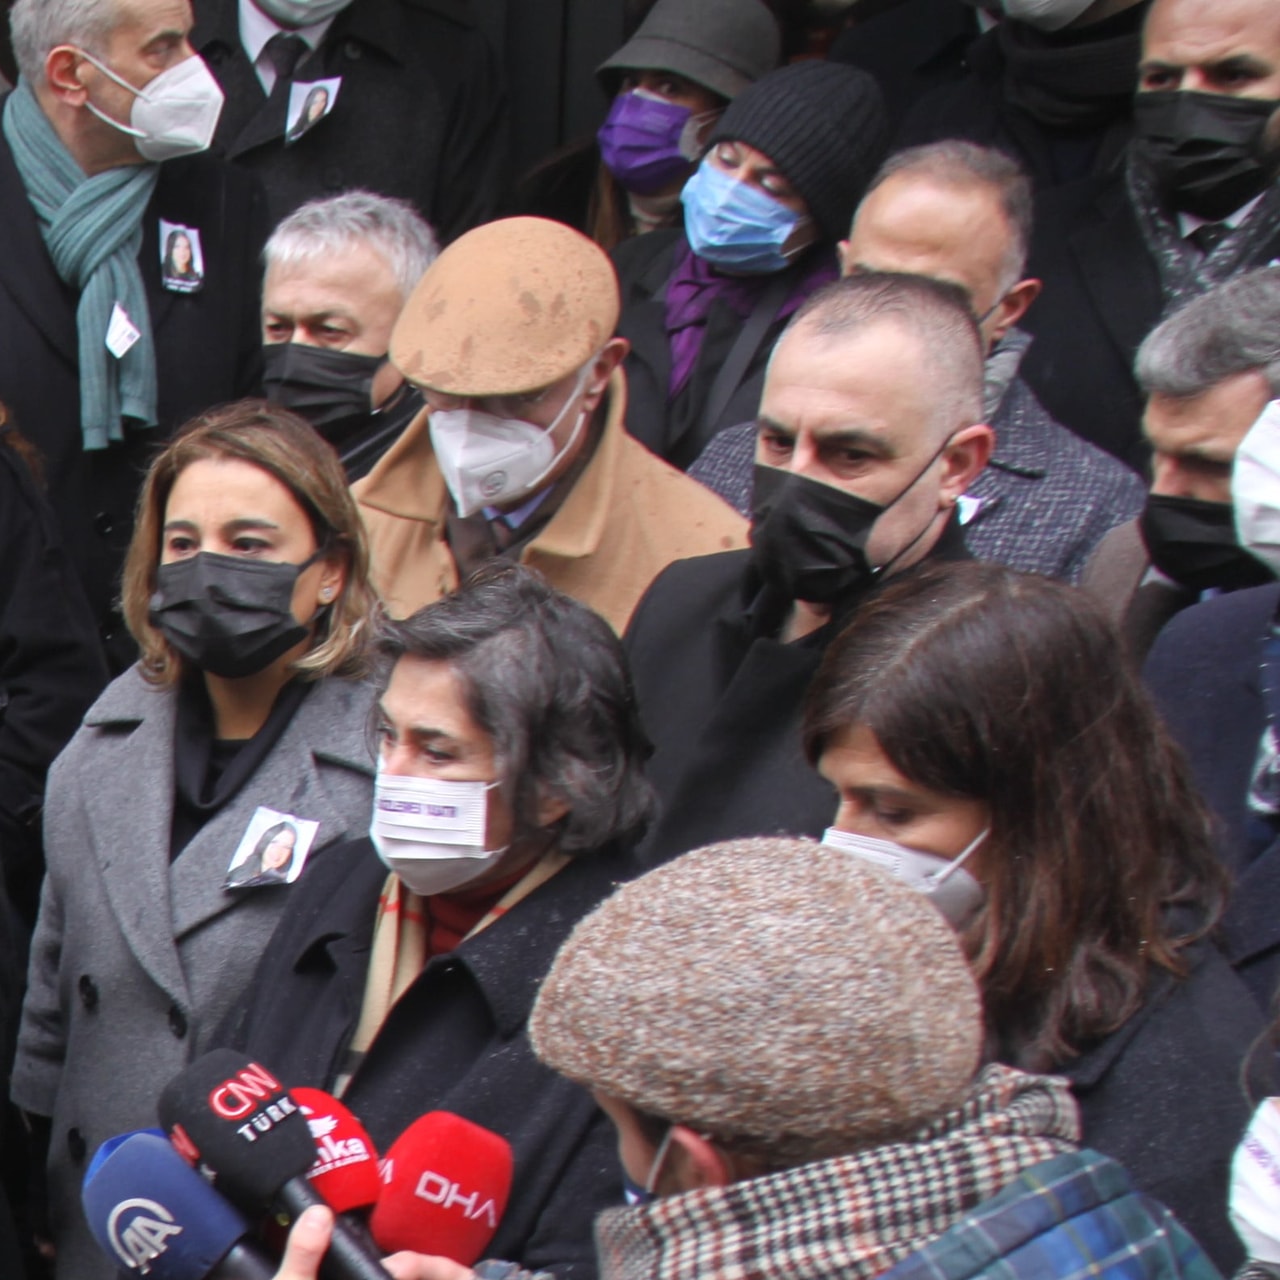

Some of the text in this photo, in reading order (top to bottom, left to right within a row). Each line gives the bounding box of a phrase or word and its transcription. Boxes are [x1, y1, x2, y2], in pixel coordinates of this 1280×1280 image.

[209, 1063, 282, 1120] CNN
[237, 1096, 297, 1141] TÜRK
[414, 1170, 496, 1228] DHA
